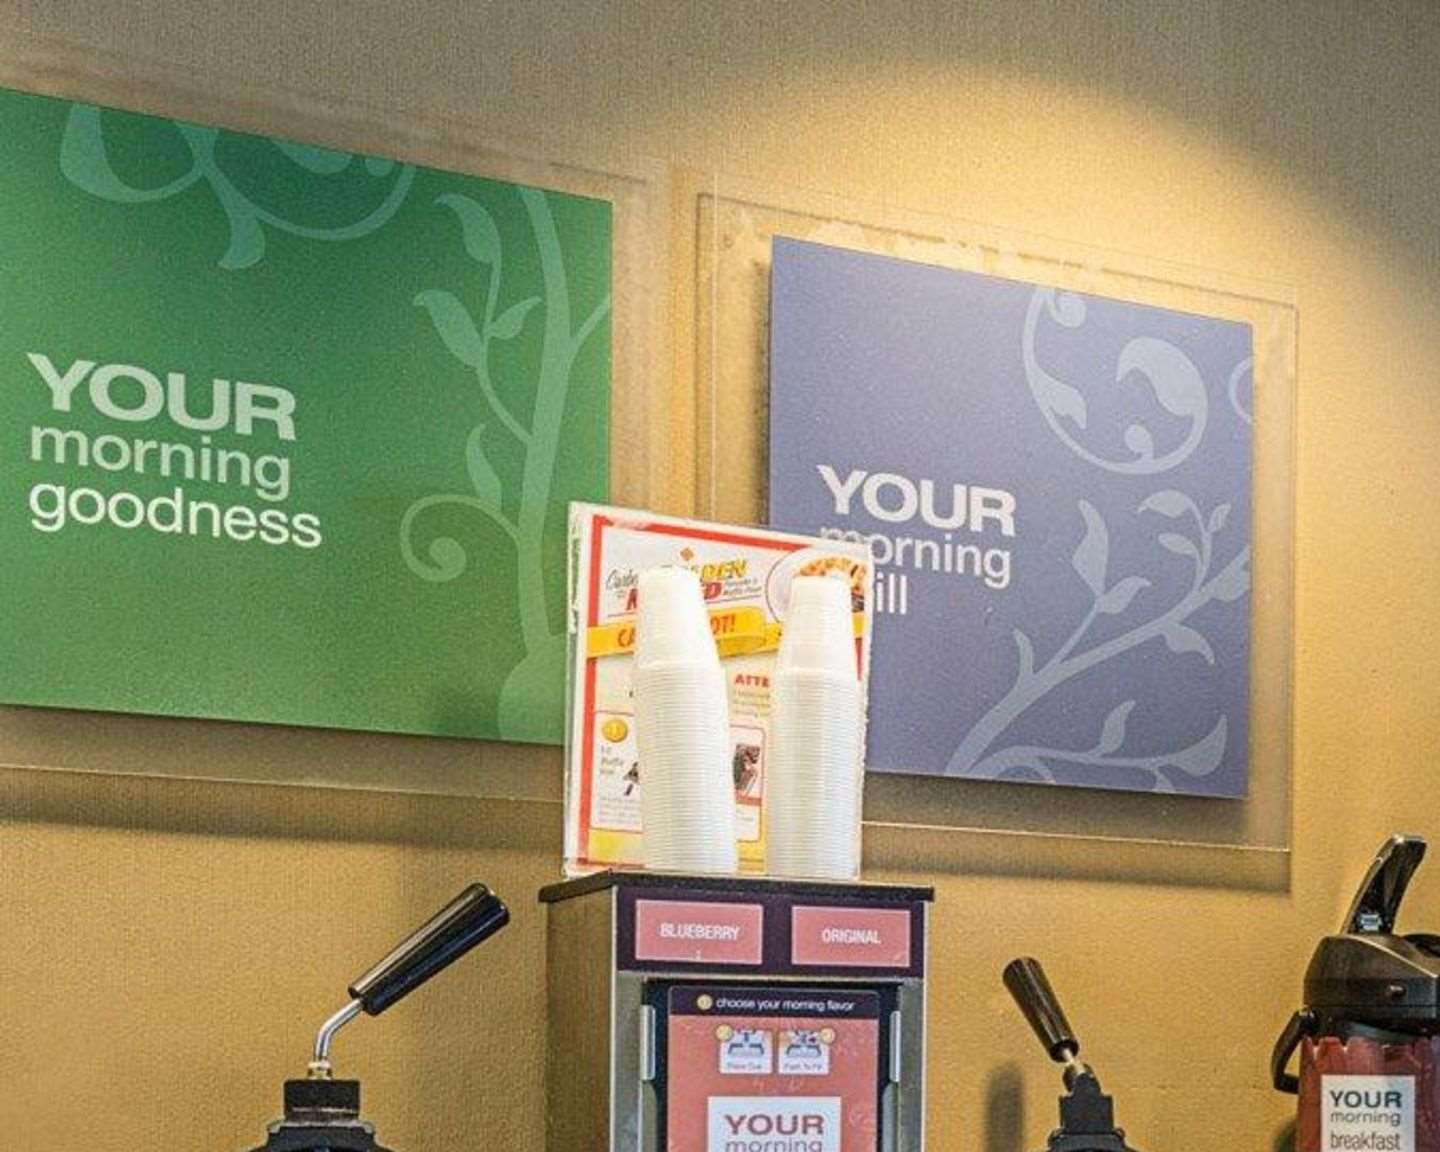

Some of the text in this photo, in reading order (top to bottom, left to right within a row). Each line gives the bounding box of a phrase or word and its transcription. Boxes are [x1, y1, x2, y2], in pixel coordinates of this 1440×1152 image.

[26, 352, 297, 441] YOUR
[30, 425, 291, 502] morning
[816, 464, 1017, 538] YOUR
[28, 482, 323, 549] goodness
[874, 571, 907, 616] ill
[659, 922, 741, 943] BLUEBERRY
[821, 926, 882, 946] ORIGINAL
[715, 998, 856, 1013] choose your morning flavor
[1329, 1089, 1403, 1109] YOUR
[724, 1113, 826, 1136] YOUR
[1330, 1110, 1401, 1127] morning
[1330, 1130, 1402, 1151] breakfast
